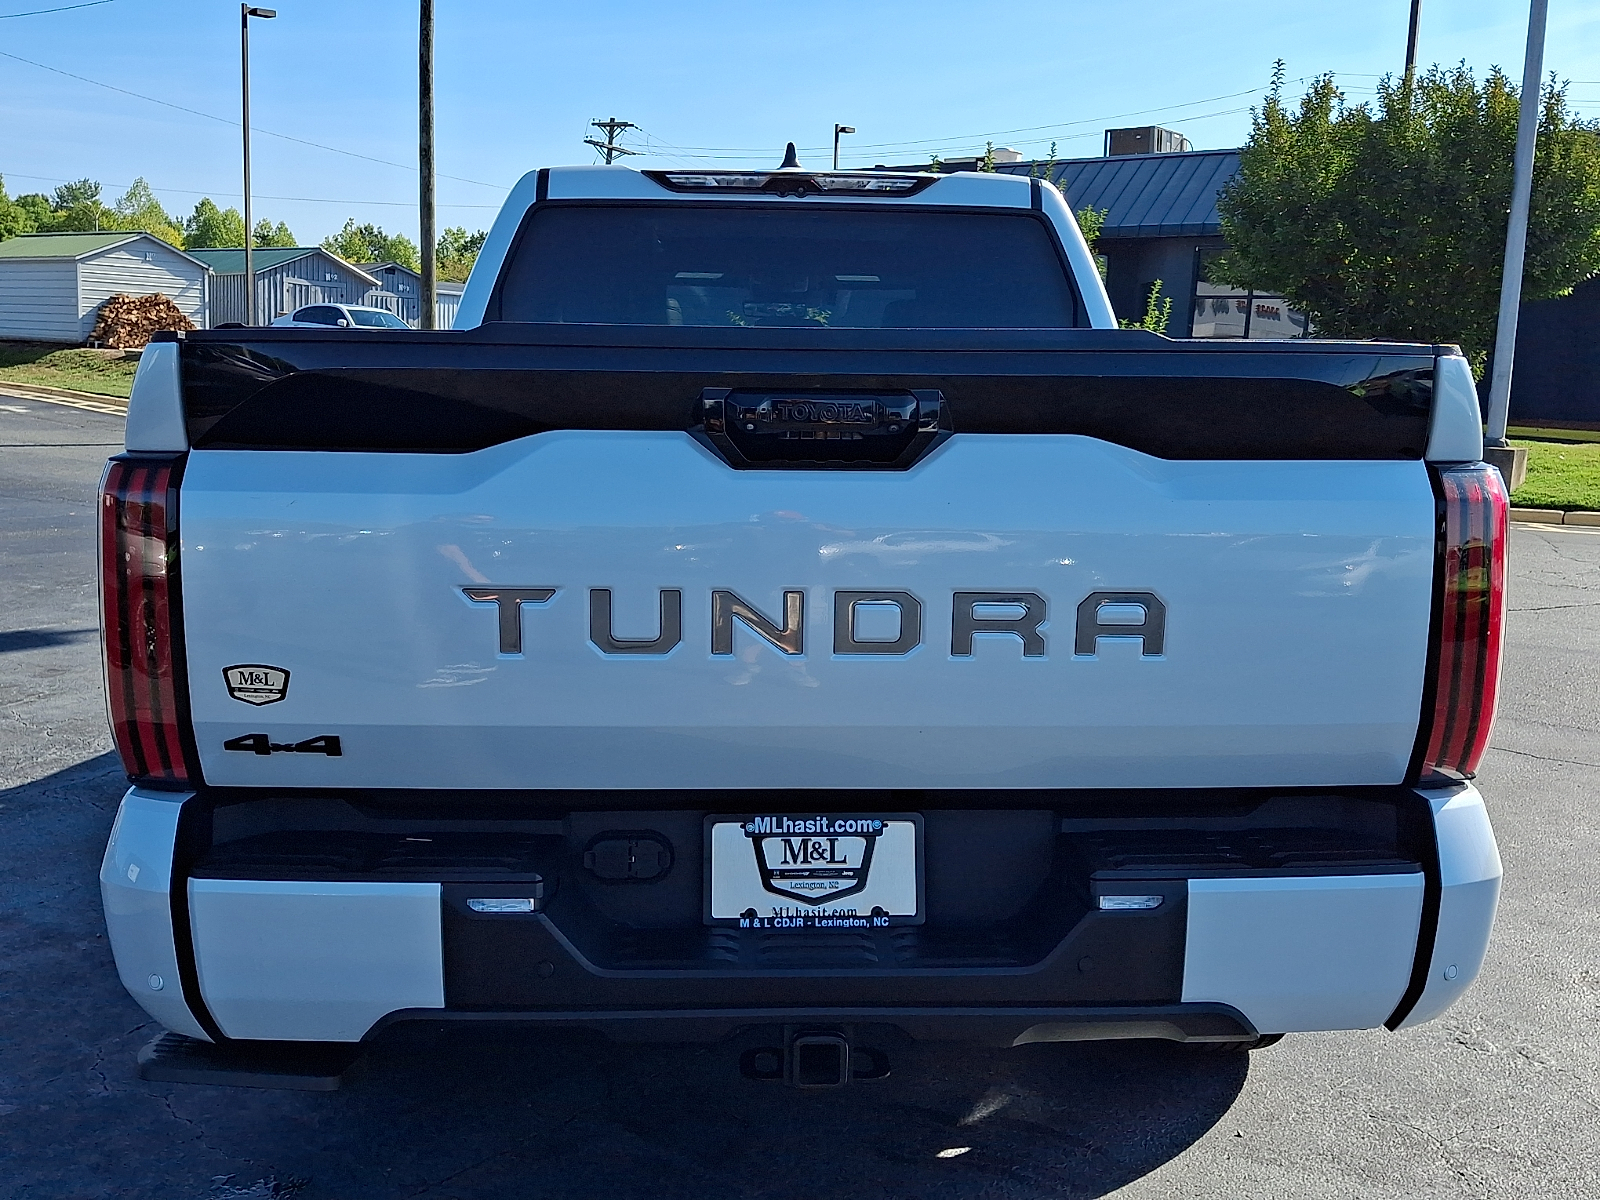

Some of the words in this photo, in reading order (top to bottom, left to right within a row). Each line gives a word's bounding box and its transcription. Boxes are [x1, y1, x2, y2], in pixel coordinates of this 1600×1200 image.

[778, 402, 867, 421] TOYOTA
[461, 586, 1167, 657] TUNDRA
[238, 670, 275, 687] M&L
[223, 732, 343, 757] 4x4
[754, 816, 874, 834] MLhasit.com
[780, 837, 848, 865] M&L
[789, 881, 827, 891] Lexington,
[828, 880, 840, 889] NC
[739, 919, 750, 928] M
[752, 918, 761, 928] &
[764, 918, 771, 928] L
[773, 918, 804, 928] CDJR
[815, 917, 870, 928] Lexington,
[873, 916, 889, 927] NC
